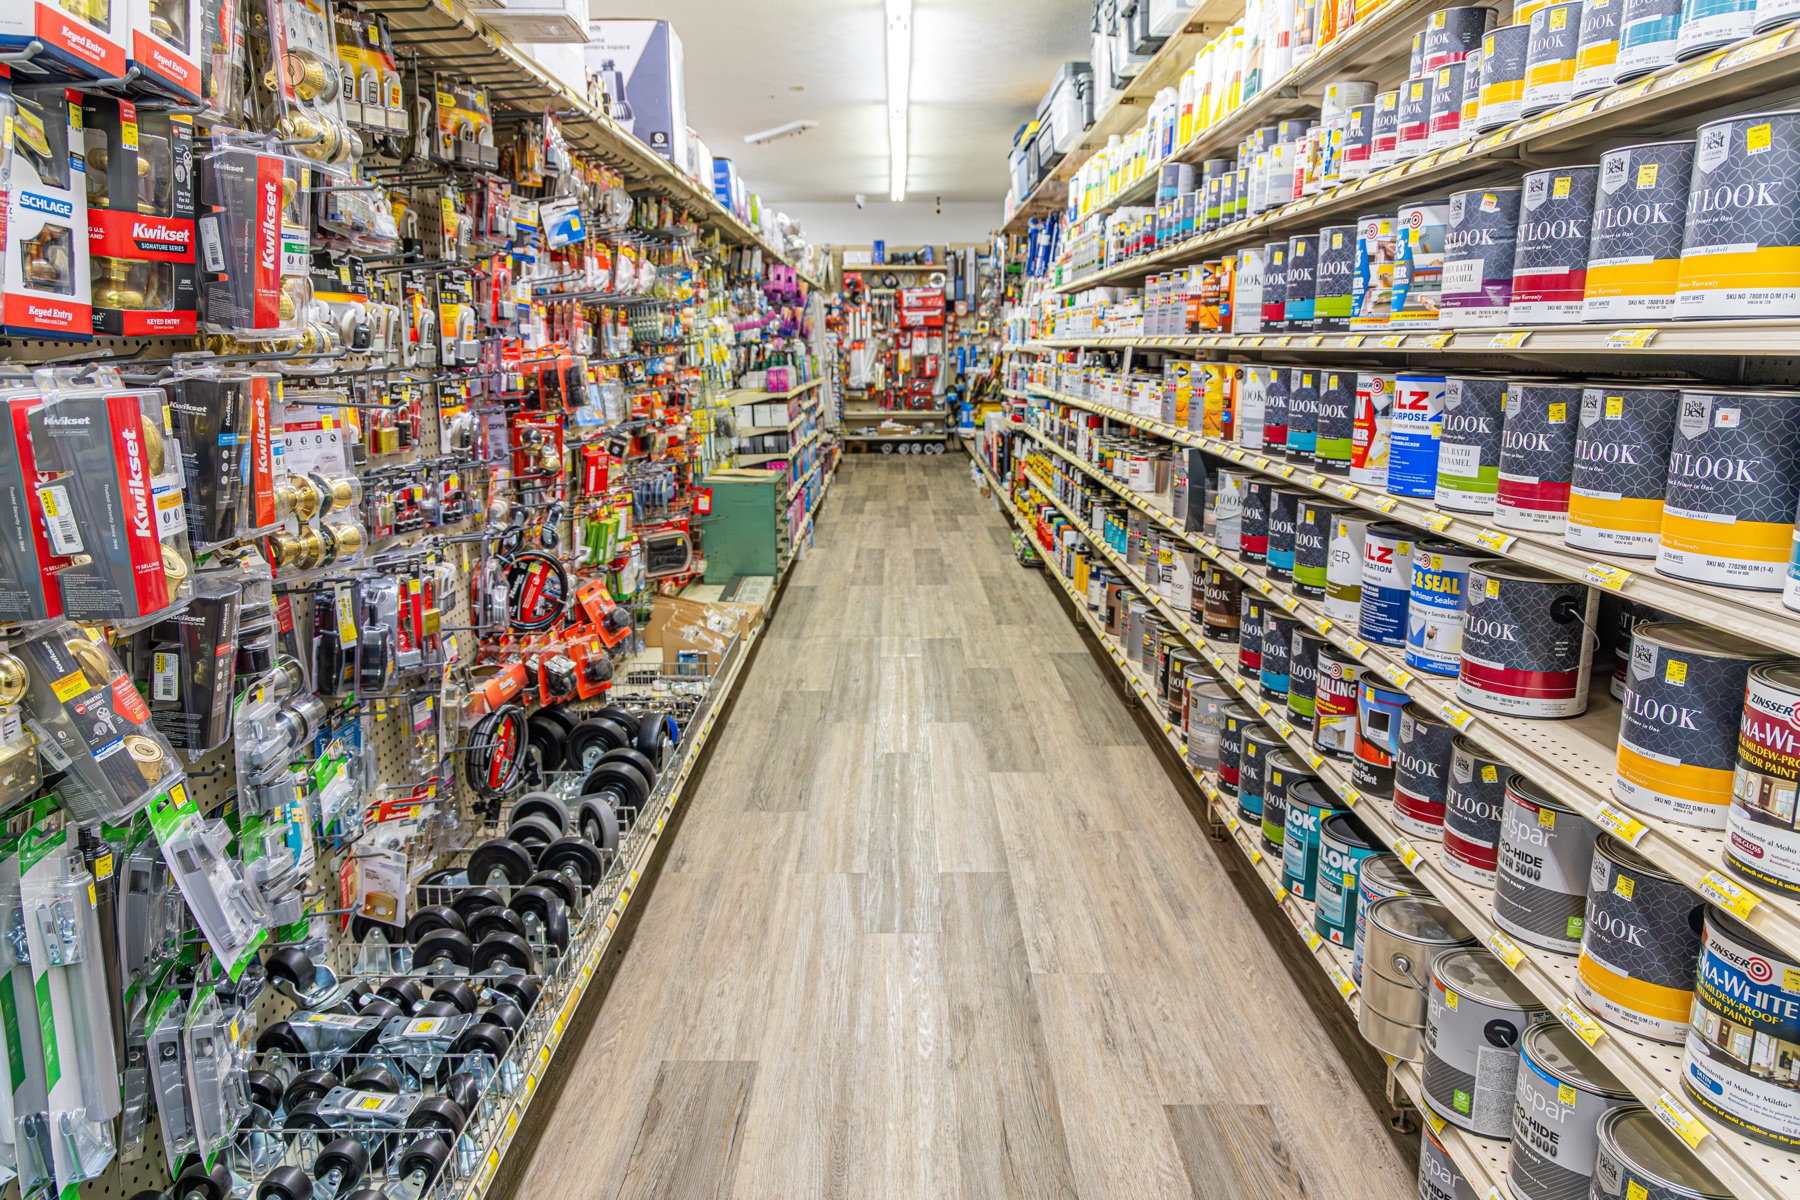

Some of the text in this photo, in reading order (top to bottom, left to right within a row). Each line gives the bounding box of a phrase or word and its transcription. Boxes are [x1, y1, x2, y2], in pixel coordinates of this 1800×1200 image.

[1584, 12, 1615, 34] LOOK
[61, 25, 106, 58] Keyed Entry
[1533, 33, 1565, 52] LOOK
[153, 50, 188, 78] Keyed Entry
[1703, 134, 1725, 152] Best
[1605, 161, 1625, 175] Best
[20, 194, 71, 216] SCHLAGE
[1701, 182, 1780, 215] LOOK
[1606, 203, 1672, 230] LOOK
[1719, 214, 1734, 223] One
[132, 222, 190, 243] Kwikset
[261, 181, 277, 271] Kwikset
[1529, 219, 1585, 240] LOOK
[141, 242, 185, 252] SIGNATURE SERIES
[1453, 228, 1496, 249] LOOK
[1704, 246, 1729, 255] Eggshell
[1318, 261, 1352, 276] LOOK
[1455, 263, 1473, 272] BATH
[1691, 279, 1719, 289] Warranty
[1782, 292, 1796, 300] (1-4)
[28, 305, 73, 321] Keyed Entry
[169, 401, 208, 413] Kwikset
[1684, 403, 1706, 419] Best
[1393, 411, 1428, 422] PURPOSE
[1447, 415, 1493, 434] LOOK
[256, 398, 268, 474] Kwikset
[1507, 430, 1554, 452] LOOK
[1451, 448, 1471, 457] BATH
[1583, 440, 1638, 465] LOOK
[1683, 455, 1758, 483] LOOK
[122, 428, 151, 538] Kwikset
[1677, 481, 1692, 490] Primer
[1574, 515, 1594, 525] Warranty
[1685, 511, 1709, 520] Eggshell
[1270, 517, 1295, 534] LOOK
[1295, 532, 1323, 549] LOOK
[1673, 540, 1700, 552] Warranty
[1673, 553, 1684, 562] WHITE
[1717, 561, 1727, 569] NO.
[1760, 565, 1774, 573] (1-4)
[1415, 570, 1461, 595] & SEAL
[1205, 587, 1231, 601] LOOK
[1415, 591, 1459, 606] Primer Sealer
[1431, 611, 1464, 622] Sands Easily
[1470, 615, 1519, 642] LOOK
[42, 640, 65, 674] Kwikset
[1263, 640, 1288, 658] LOOK
[1421, 650, 1436, 658] Stains
[1320, 674, 1357, 699] KILLING
[1635, 692, 1701, 731] LOOK
[1751, 693, 1795, 717] ZINSSER
[1648, 724, 1660, 733] One
[1359, 760, 1369, 772] Flat
[1401, 752, 1441, 779] LOOK
[1764, 761, 1799, 780] PAINT
[1360, 770, 1377, 785] Paint
[1625, 770, 1649, 786] Warranty
[1456, 795, 1503, 822] LOOK
[1654, 796, 1664, 804] SKU
[1664, 799, 1673, 807] NO.
[1703, 806, 1716, 815] (1-4)
[1775, 843, 1797, 855] Moho
[1515, 862, 1541, 881] 5000
[1741, 864, 1757, 877] growth
[1763, 874, 1778, 885] mold
[1510, 878, 1526, 891] PAINT
[1590, 902, 1648, 948] LOOK
[1601, 934, 1611, 944] One
[1709, 939, 1751, 970] ZINSSER
[1705, 980, 1780, 1025] MILDEW-PROOF
[1605, 1002, 1614, 1011] SKU
[1648, 1017, 1660, 1027] (1-4)
[1723, 1005, 1755, 1027] PAINT
[1696, 1069, 1712, 1085] SATIN
[1733, 1083, 1755, 1097] Moho
[1702, 1098, 1719, 1114] growth
[1718, 1109, 1725, 1117] of
[1725, 1114, 1739, 1124] mold
[1745, 1124, 1769, 1136] mildew
[1778, 1135, 1789, 1143] the
[1530, 1133, 1558, 1158] 5000
[1525, 1149, 1542, 1165] PAINT
